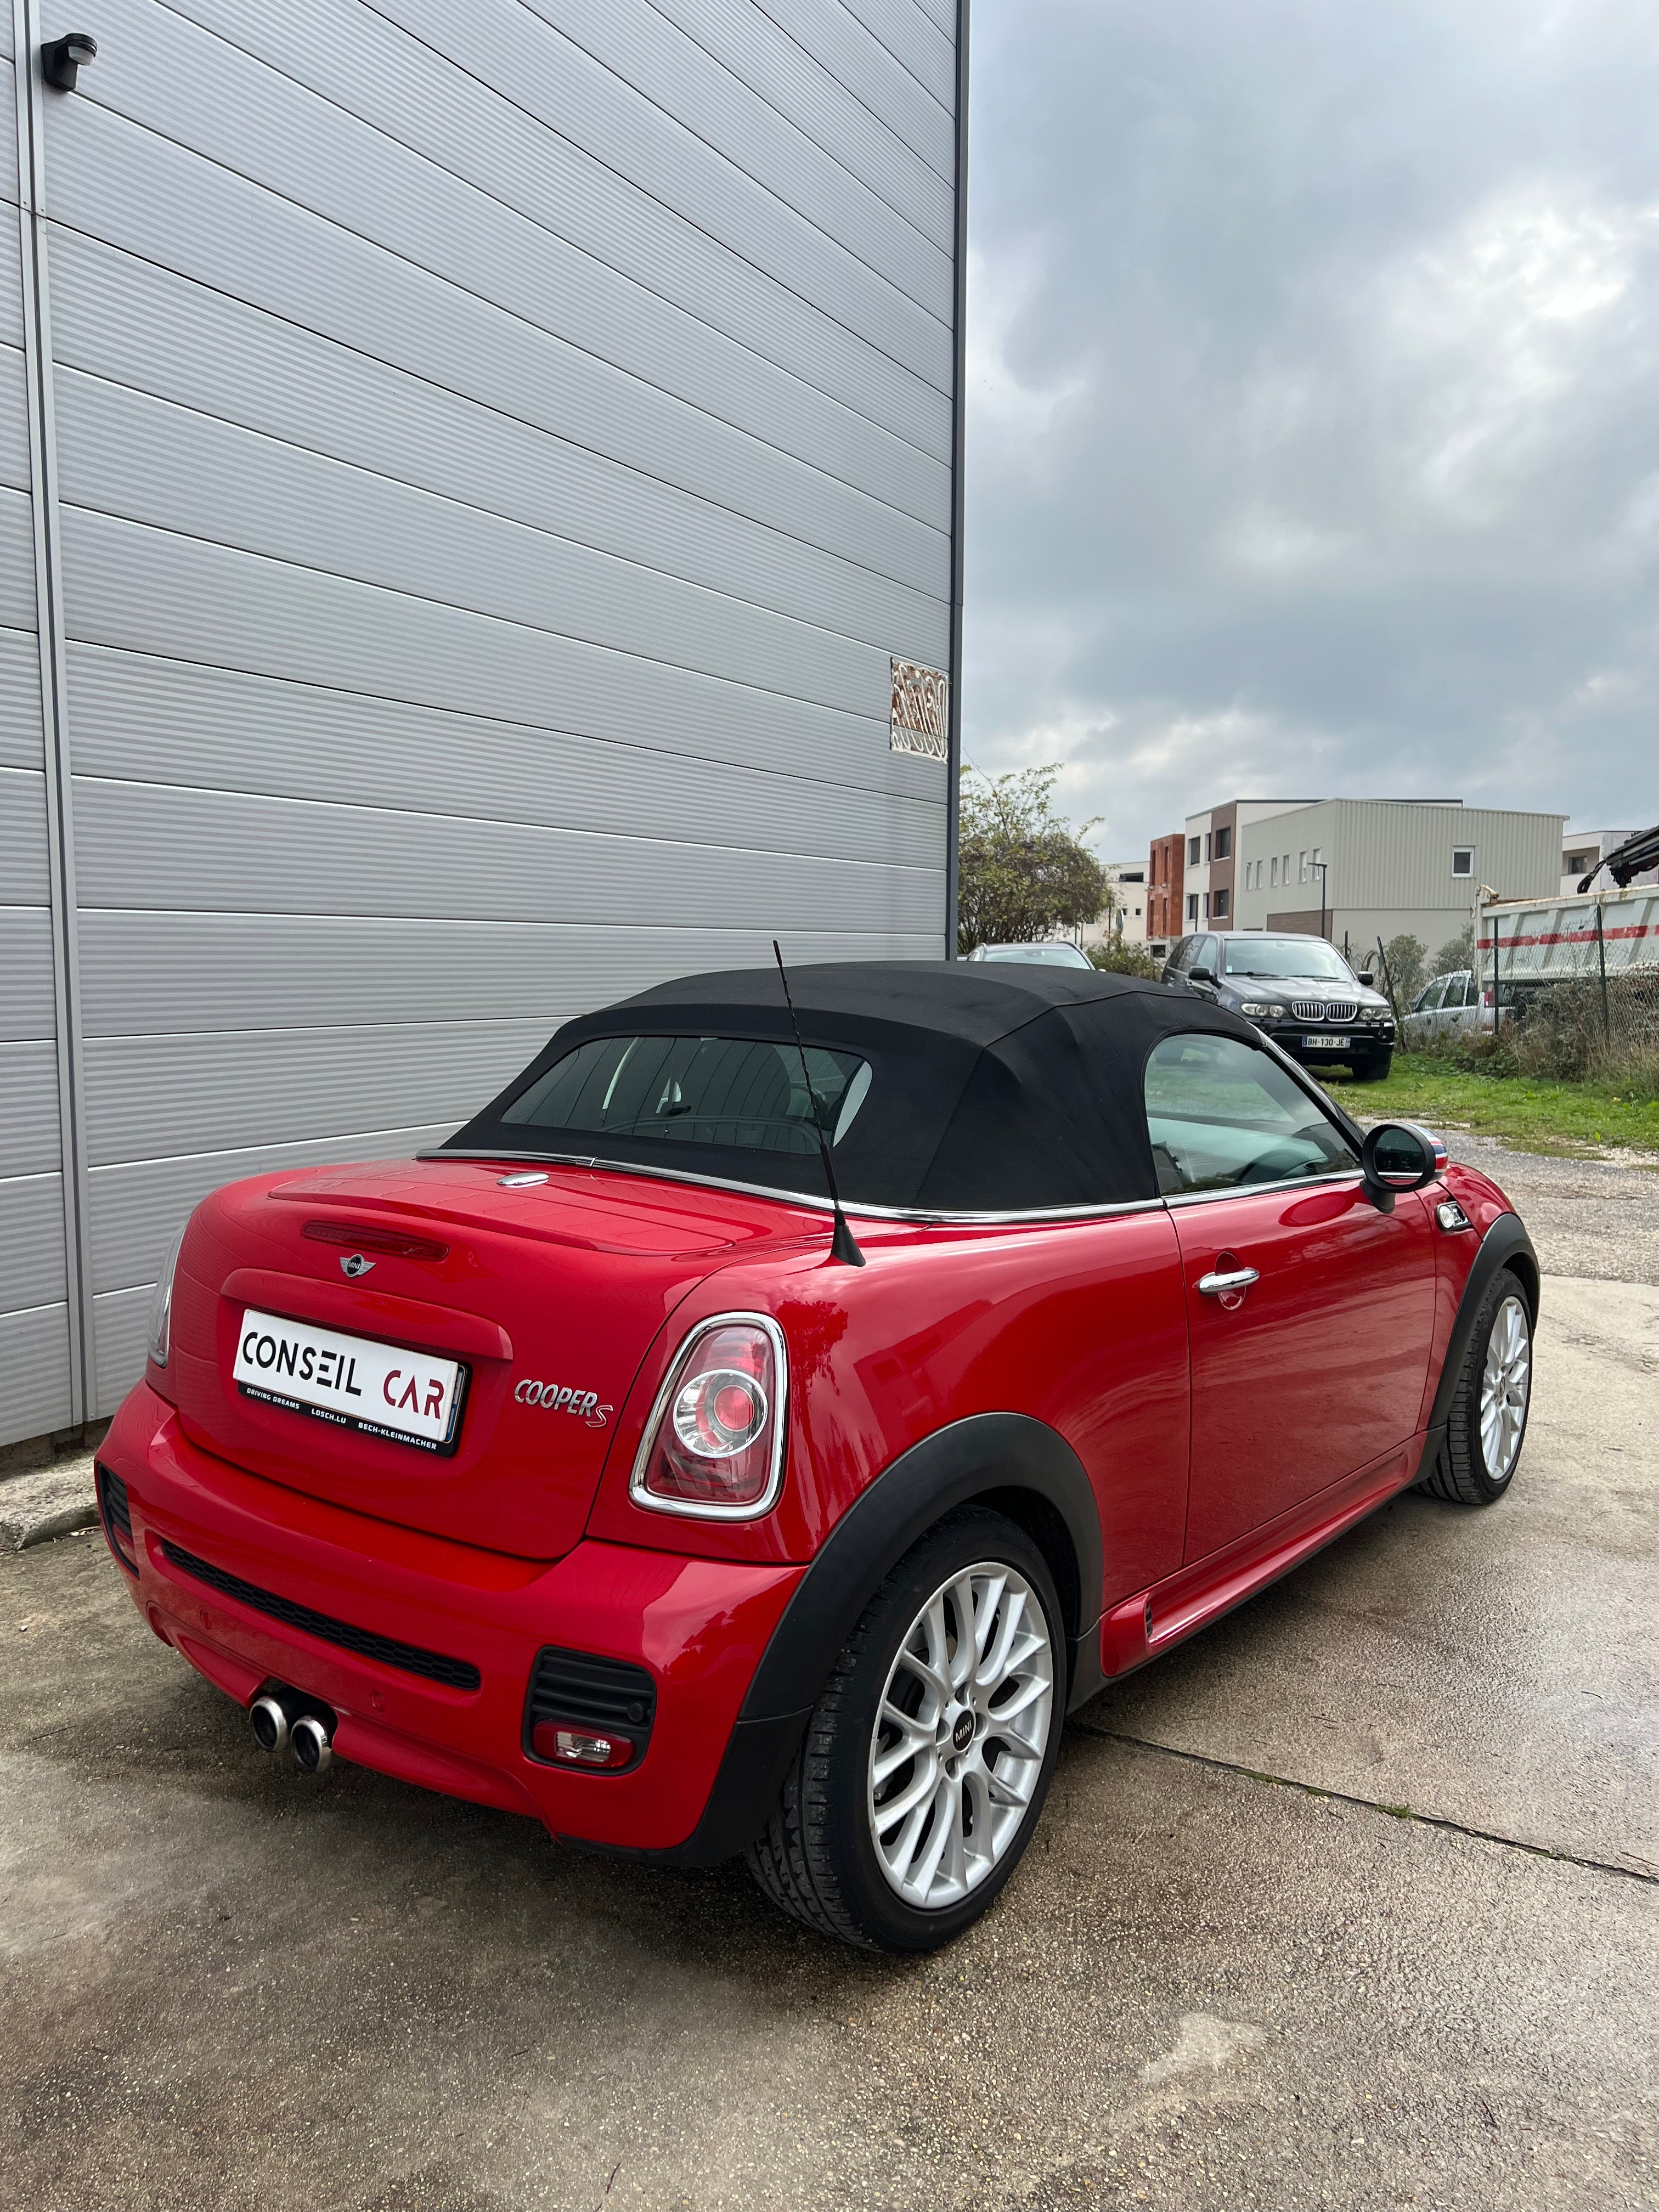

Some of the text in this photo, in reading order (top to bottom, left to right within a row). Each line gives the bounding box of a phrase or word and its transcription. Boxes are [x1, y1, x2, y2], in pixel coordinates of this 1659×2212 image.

[348, 1261, 361, 1269] MINI
[242, 1331, 444, 1420] CONSEIL CAR
[246, 1387, 300, 1409] DRIVING DREAMS
[514, 1379, 613, 1427] COOPER S
[311, 1408, 346, 1424] LOSCH.LU
[358, 1422, 437, 1451] BECH-KLEINMACHER
[955, 1720, 972, 1742] MINI
